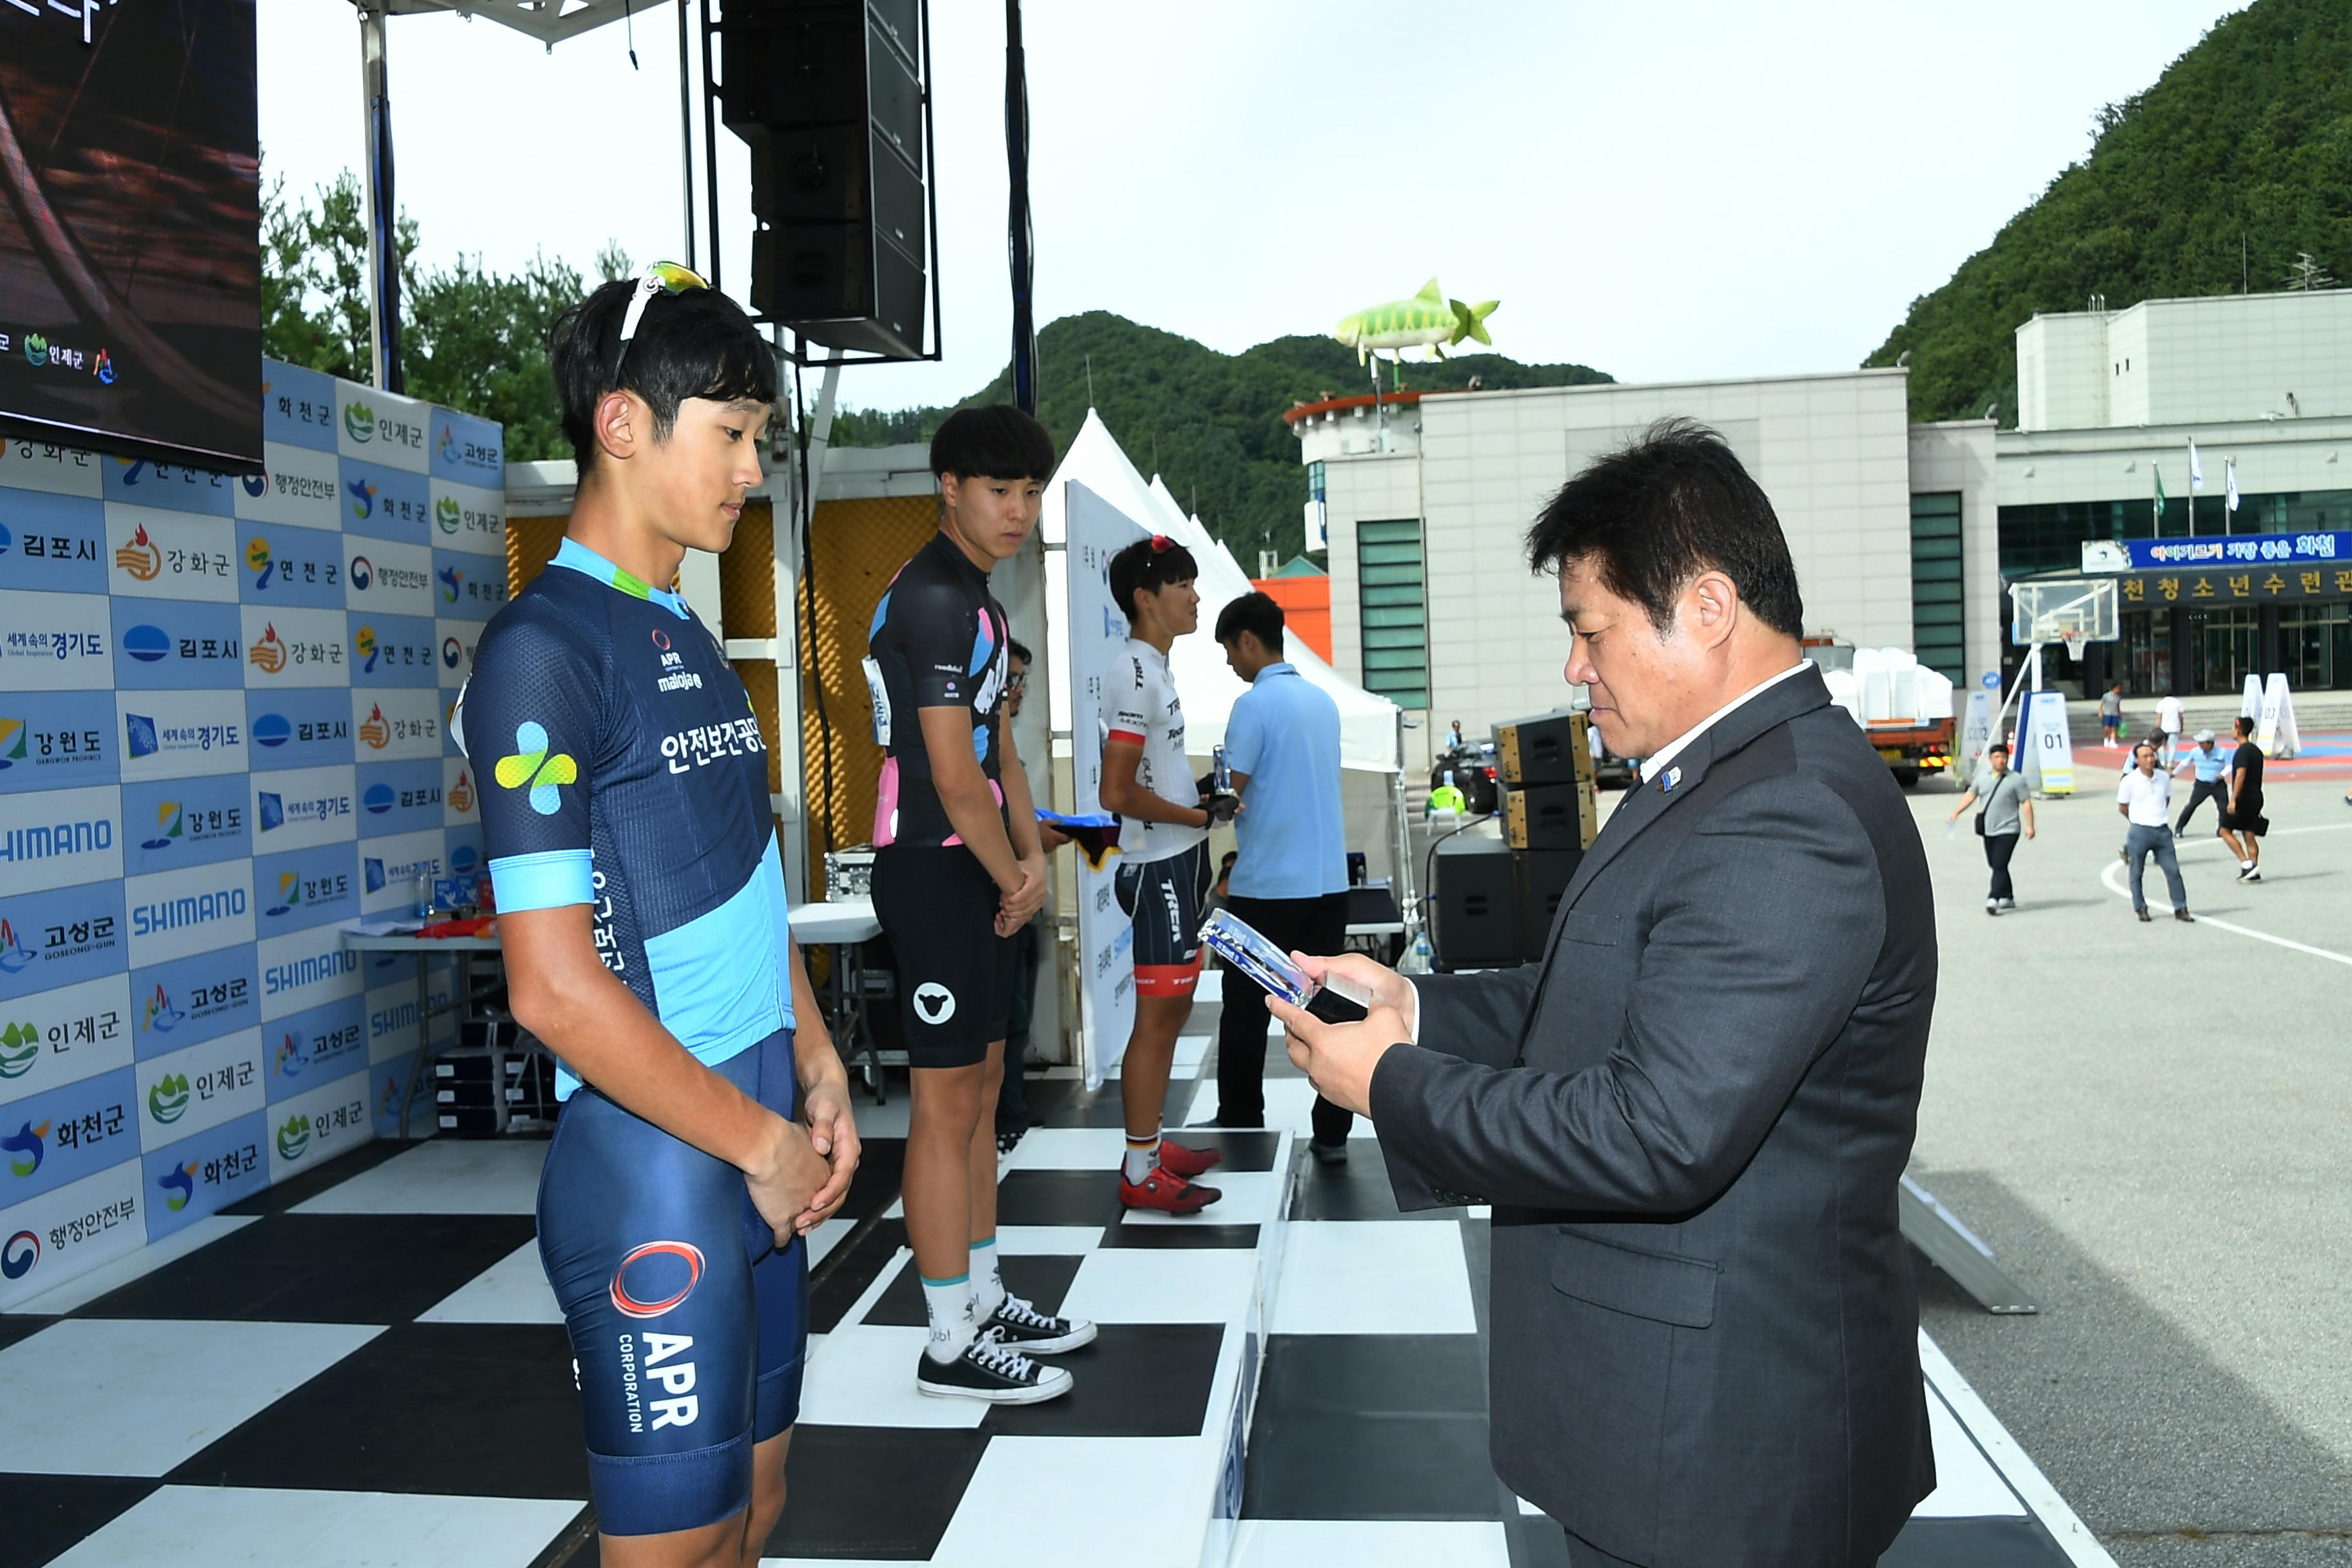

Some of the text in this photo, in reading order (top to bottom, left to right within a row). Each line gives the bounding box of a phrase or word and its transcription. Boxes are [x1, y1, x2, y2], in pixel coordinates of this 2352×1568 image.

[49, 345, 83, 370] 인제군
[279, 397, 330, 426] 화천군
[379, 419, 423, 448] 인제군
[465, 442, 498, 463] 고성군
[275, 473, 335, 499] 행정안전부
[384, 498, 426, 523] 화천군
[464, 511, 498, 533] 인제군
[23, 534, 97, 561] 김포시
[168, 549, 230, 577] 강화군
[280, 560, 337, 584] 연천군
[8, 632, 104, 660] 세계 속의 경기도
[179, 638, 238, 659] 김포시
[291, 643, 343, 665] 강화군
[384, 645, 432, 665] 연천군
[660, 652, 682, 667] APR
[658, 671, 694, 692] maloja
[198, 725, 239, 750] 경기도
[299, 721, 348, 741] 김포시
[394, 719, 436, 739] 강화군
[2044, 734, 2063, 749] 01
[35, 730, 101, 755] 강원도
[317, 797, 350, 821] 경기도
[401, 789, 441, 807] 김포시
[188, 808, 241, 833] 강원도
[133, 888, 246, 936] SHIMANO
[44, 916, 115, 948] 고성군
[266, 949, 357, 995] SHIMANO
[191, 977, 248, 1009] 고성군
[48, 1011, 121, 1054] 인제군
[313, 1024, 359, 1054] 고성군
[196, 1061, 255, 1099] 인제군
[57, 1103, 125, 1149] 화천군
[315, 1101, 363, 1138] 인제군
[204, 1144, 259, 1185] 화천군
[49, 1197, 136, 1250] 행정안전부
[620, 1334, 643, 1433] CORPORATION
[642, 1331, 700, 1431] APR
